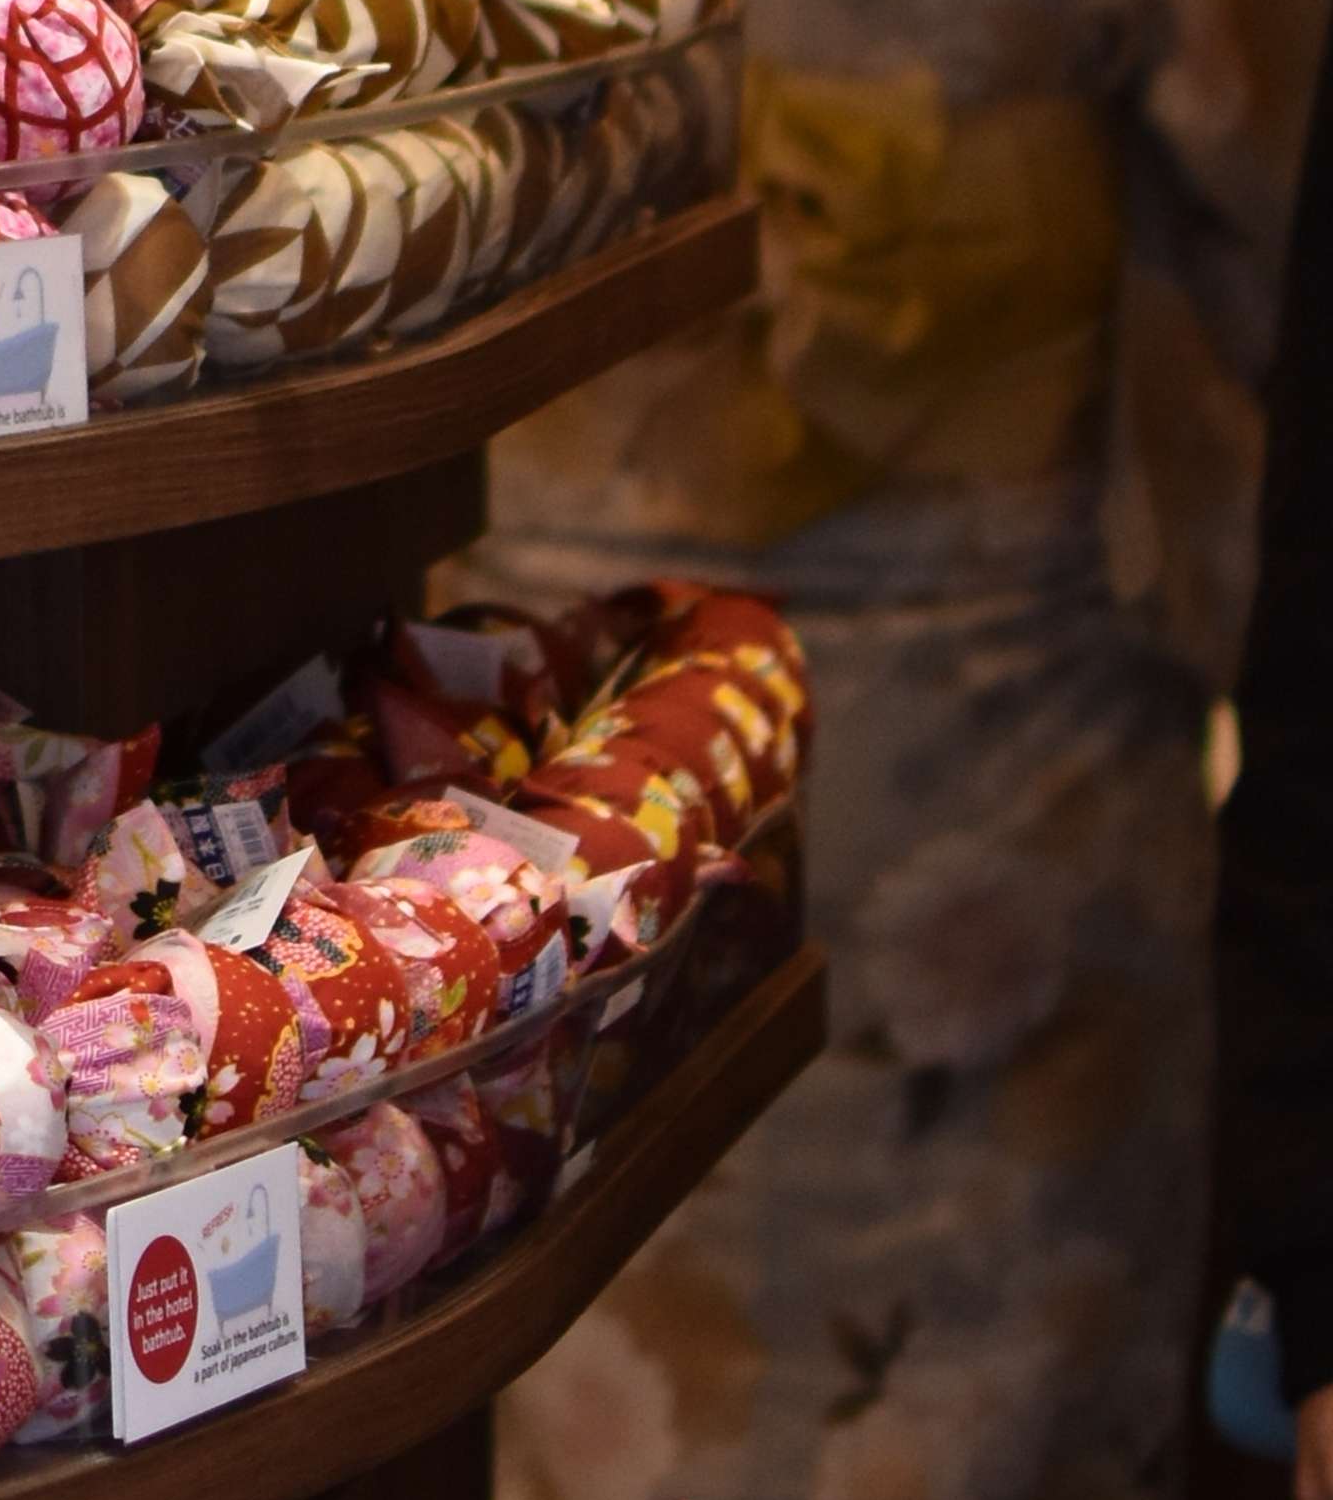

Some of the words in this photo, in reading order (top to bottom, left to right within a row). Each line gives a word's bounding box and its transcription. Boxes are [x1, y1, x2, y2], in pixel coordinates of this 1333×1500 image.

[13, 403, 55, 426] bathtub
[57, 404, 66, 420] is
[190, 813, 227, 880] 日本製
[136, 1277, 158, 1303] Just
[160, 1273, 179, 1296] put
[179, 1266, 189, 1286] it
[133, 1307, 145, 1331] in
[146, 1301, 165, 1326] the
[166, 1290, 194, 1320] hotel
[141, 1324, 187, 1355] bathtub.
[193, 1370, 200, 1384] a
[200, 1358, 220, 1383] part
[220, 1353, 231, 1372] of
[268, 1330, 300, 1358] culture.
[200, 1339, 223, 1362] Soak
[223, 1336, 233, 1352] in
[233, 1330, 247, 1350] the
[247, 1319, 283, 1344] bathtub
[283, 1312, 290, 1327] is
